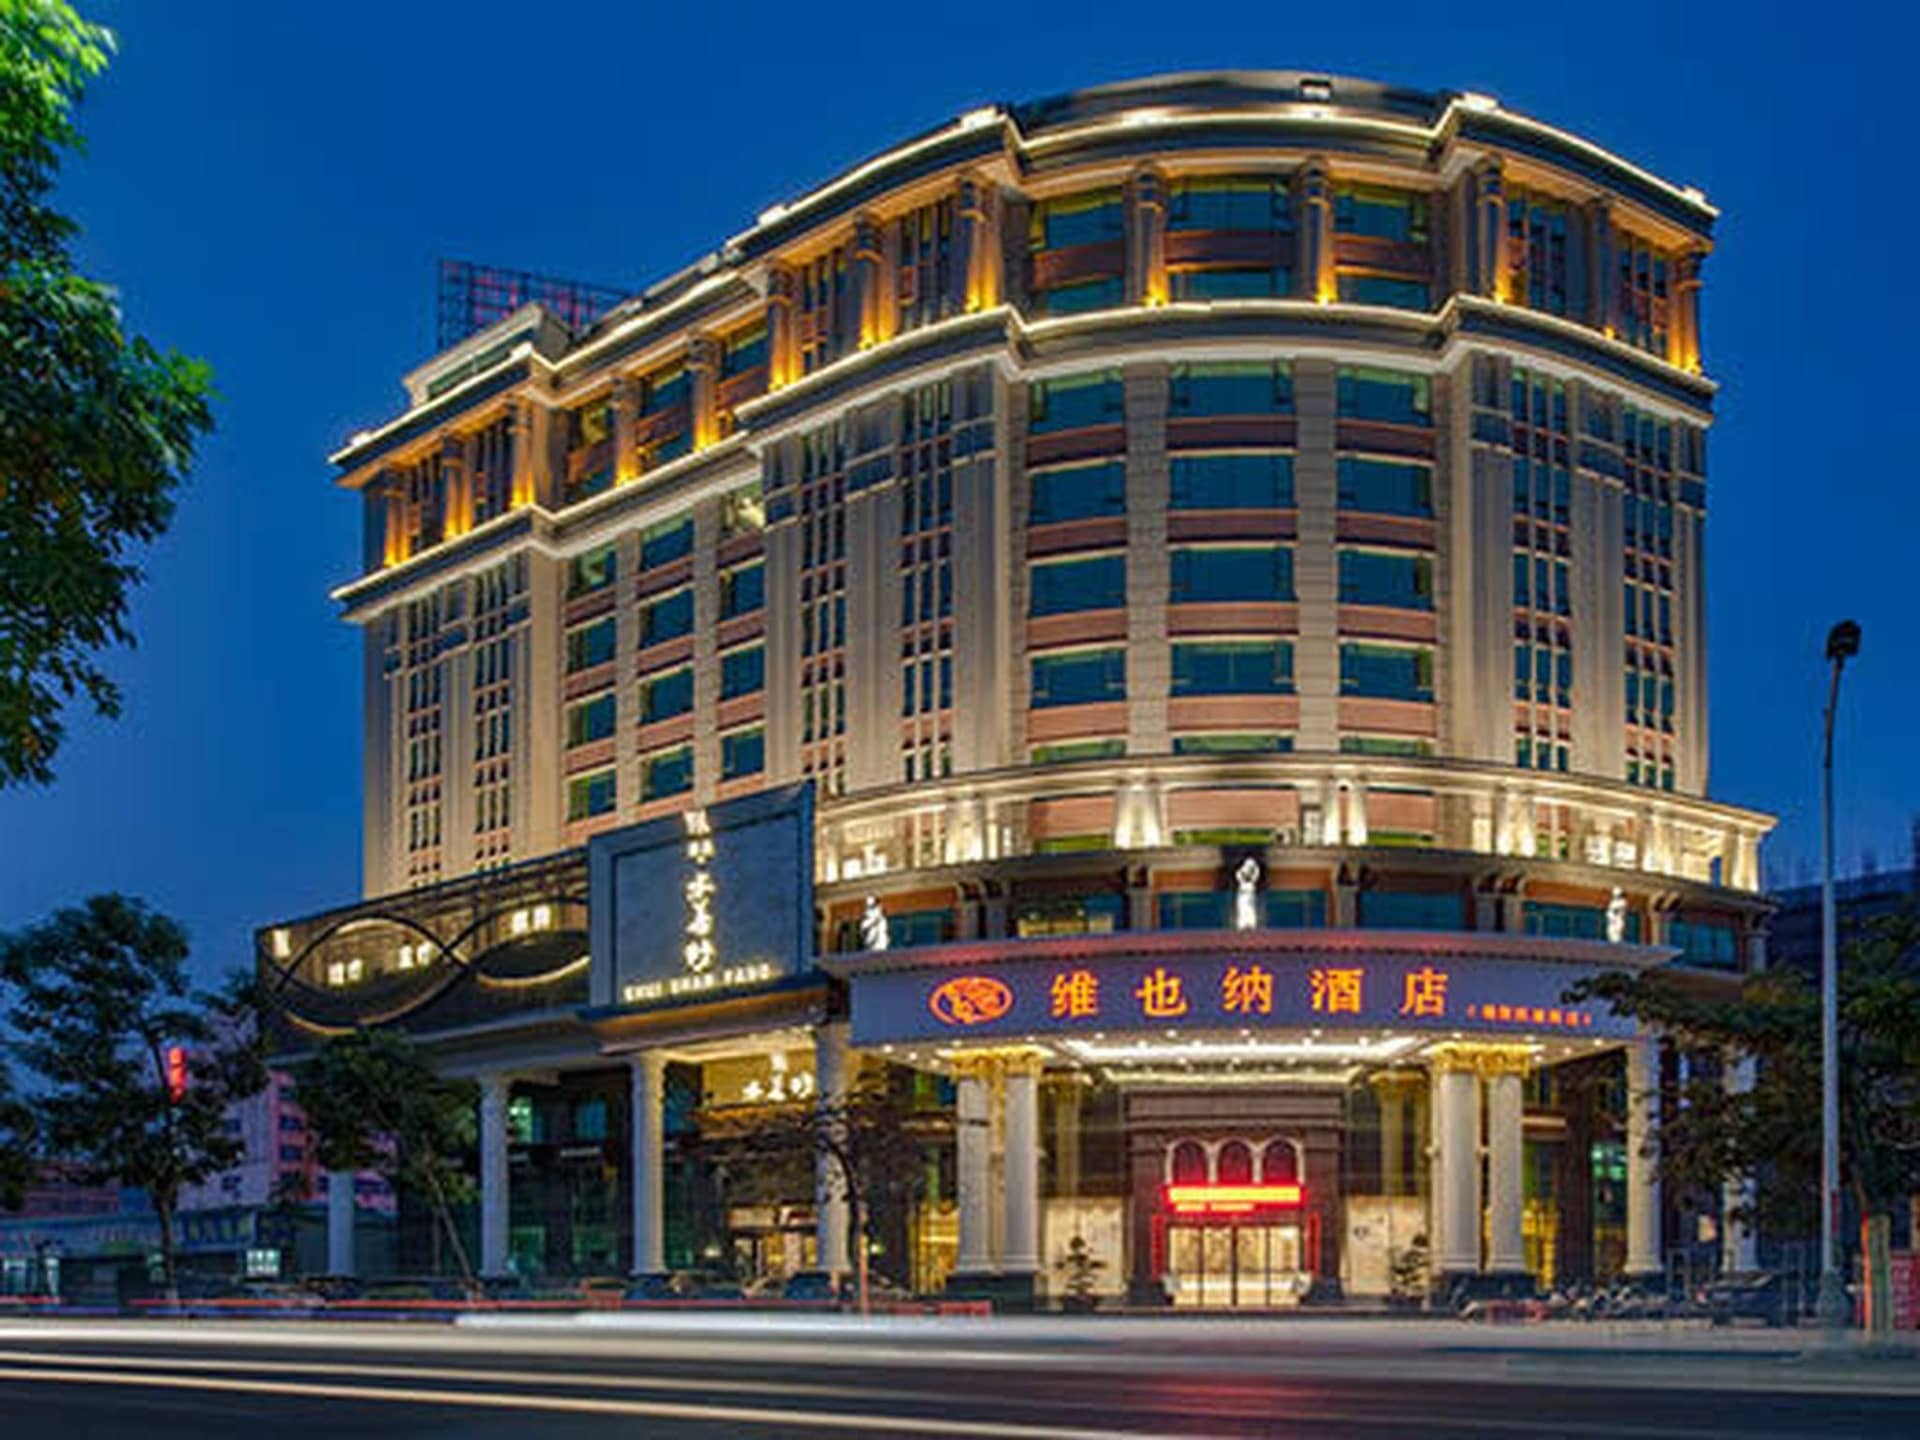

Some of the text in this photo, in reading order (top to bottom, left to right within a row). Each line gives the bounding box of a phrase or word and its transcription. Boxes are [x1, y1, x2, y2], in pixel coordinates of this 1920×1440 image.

[1051, 965, 1449, 1017] 维也纳酒店
